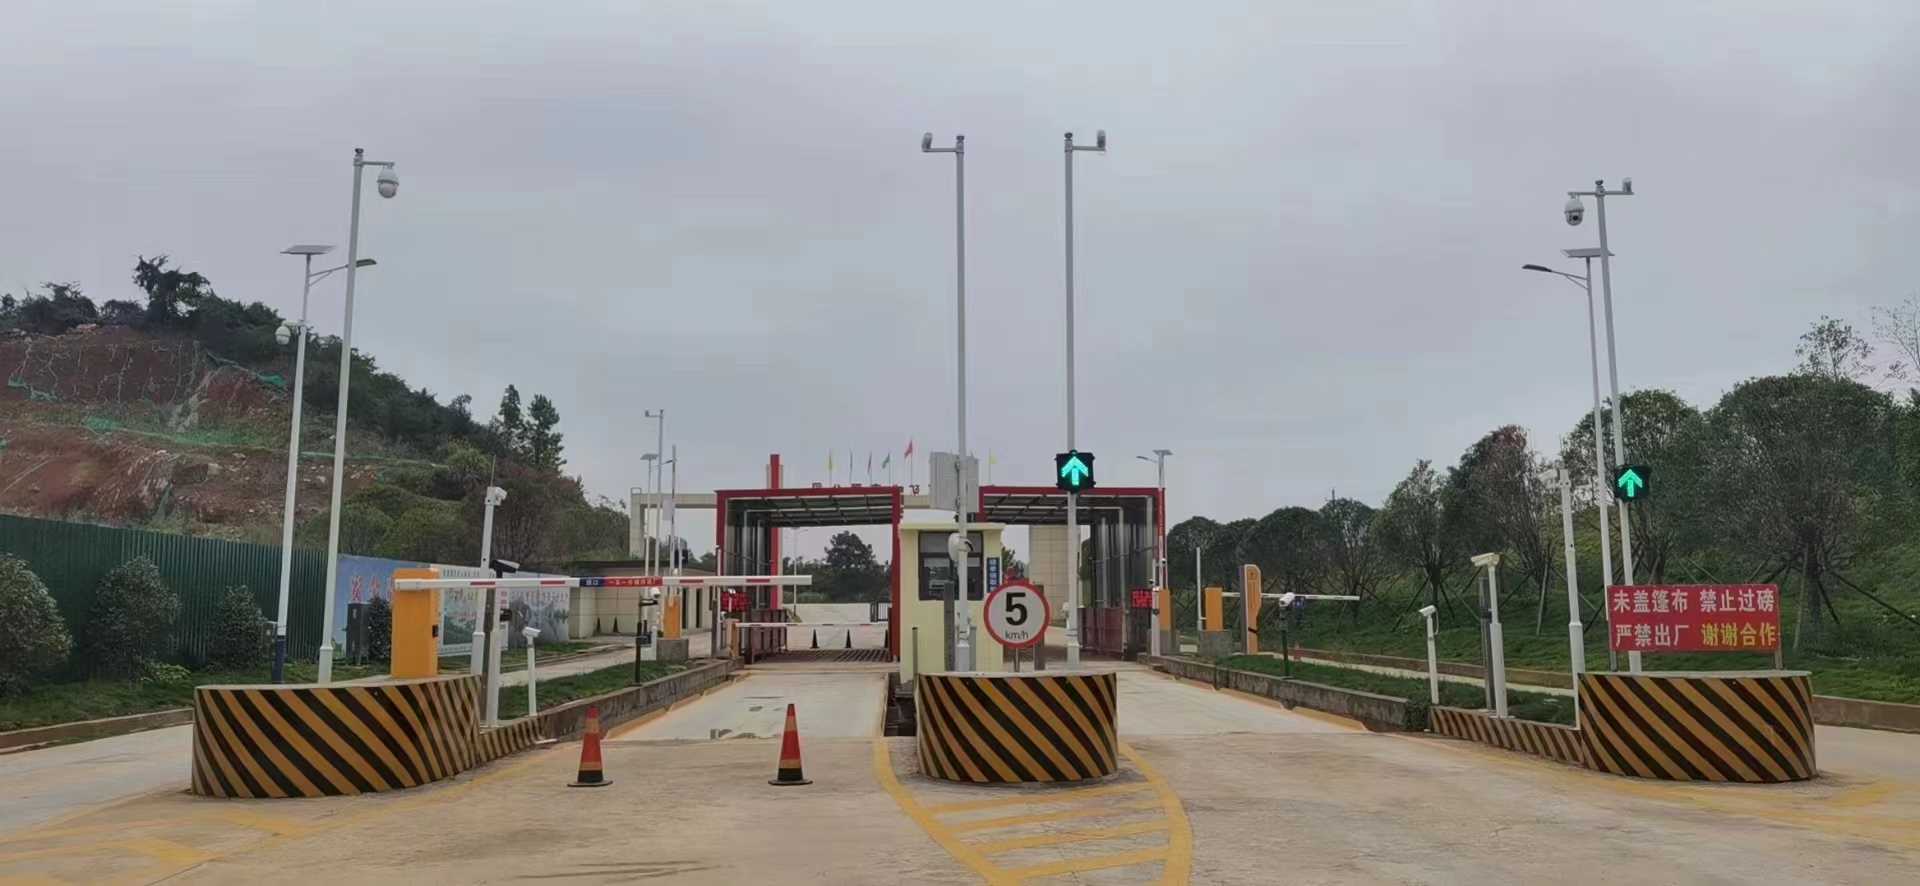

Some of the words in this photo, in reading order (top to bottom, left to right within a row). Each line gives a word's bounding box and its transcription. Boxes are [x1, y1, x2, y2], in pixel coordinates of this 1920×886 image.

[1006, 592, 1027, 626] 5
[1613, 589, 1688, 613] 未盖篷布
[1700, 589, 1774, 613] 禁止过磅
[1005, 630, 1029, 640] km/h
[1615, 624, 1689, 648] 严禁出厂
[1701, 622, 1776, 647] 谢谢合作
